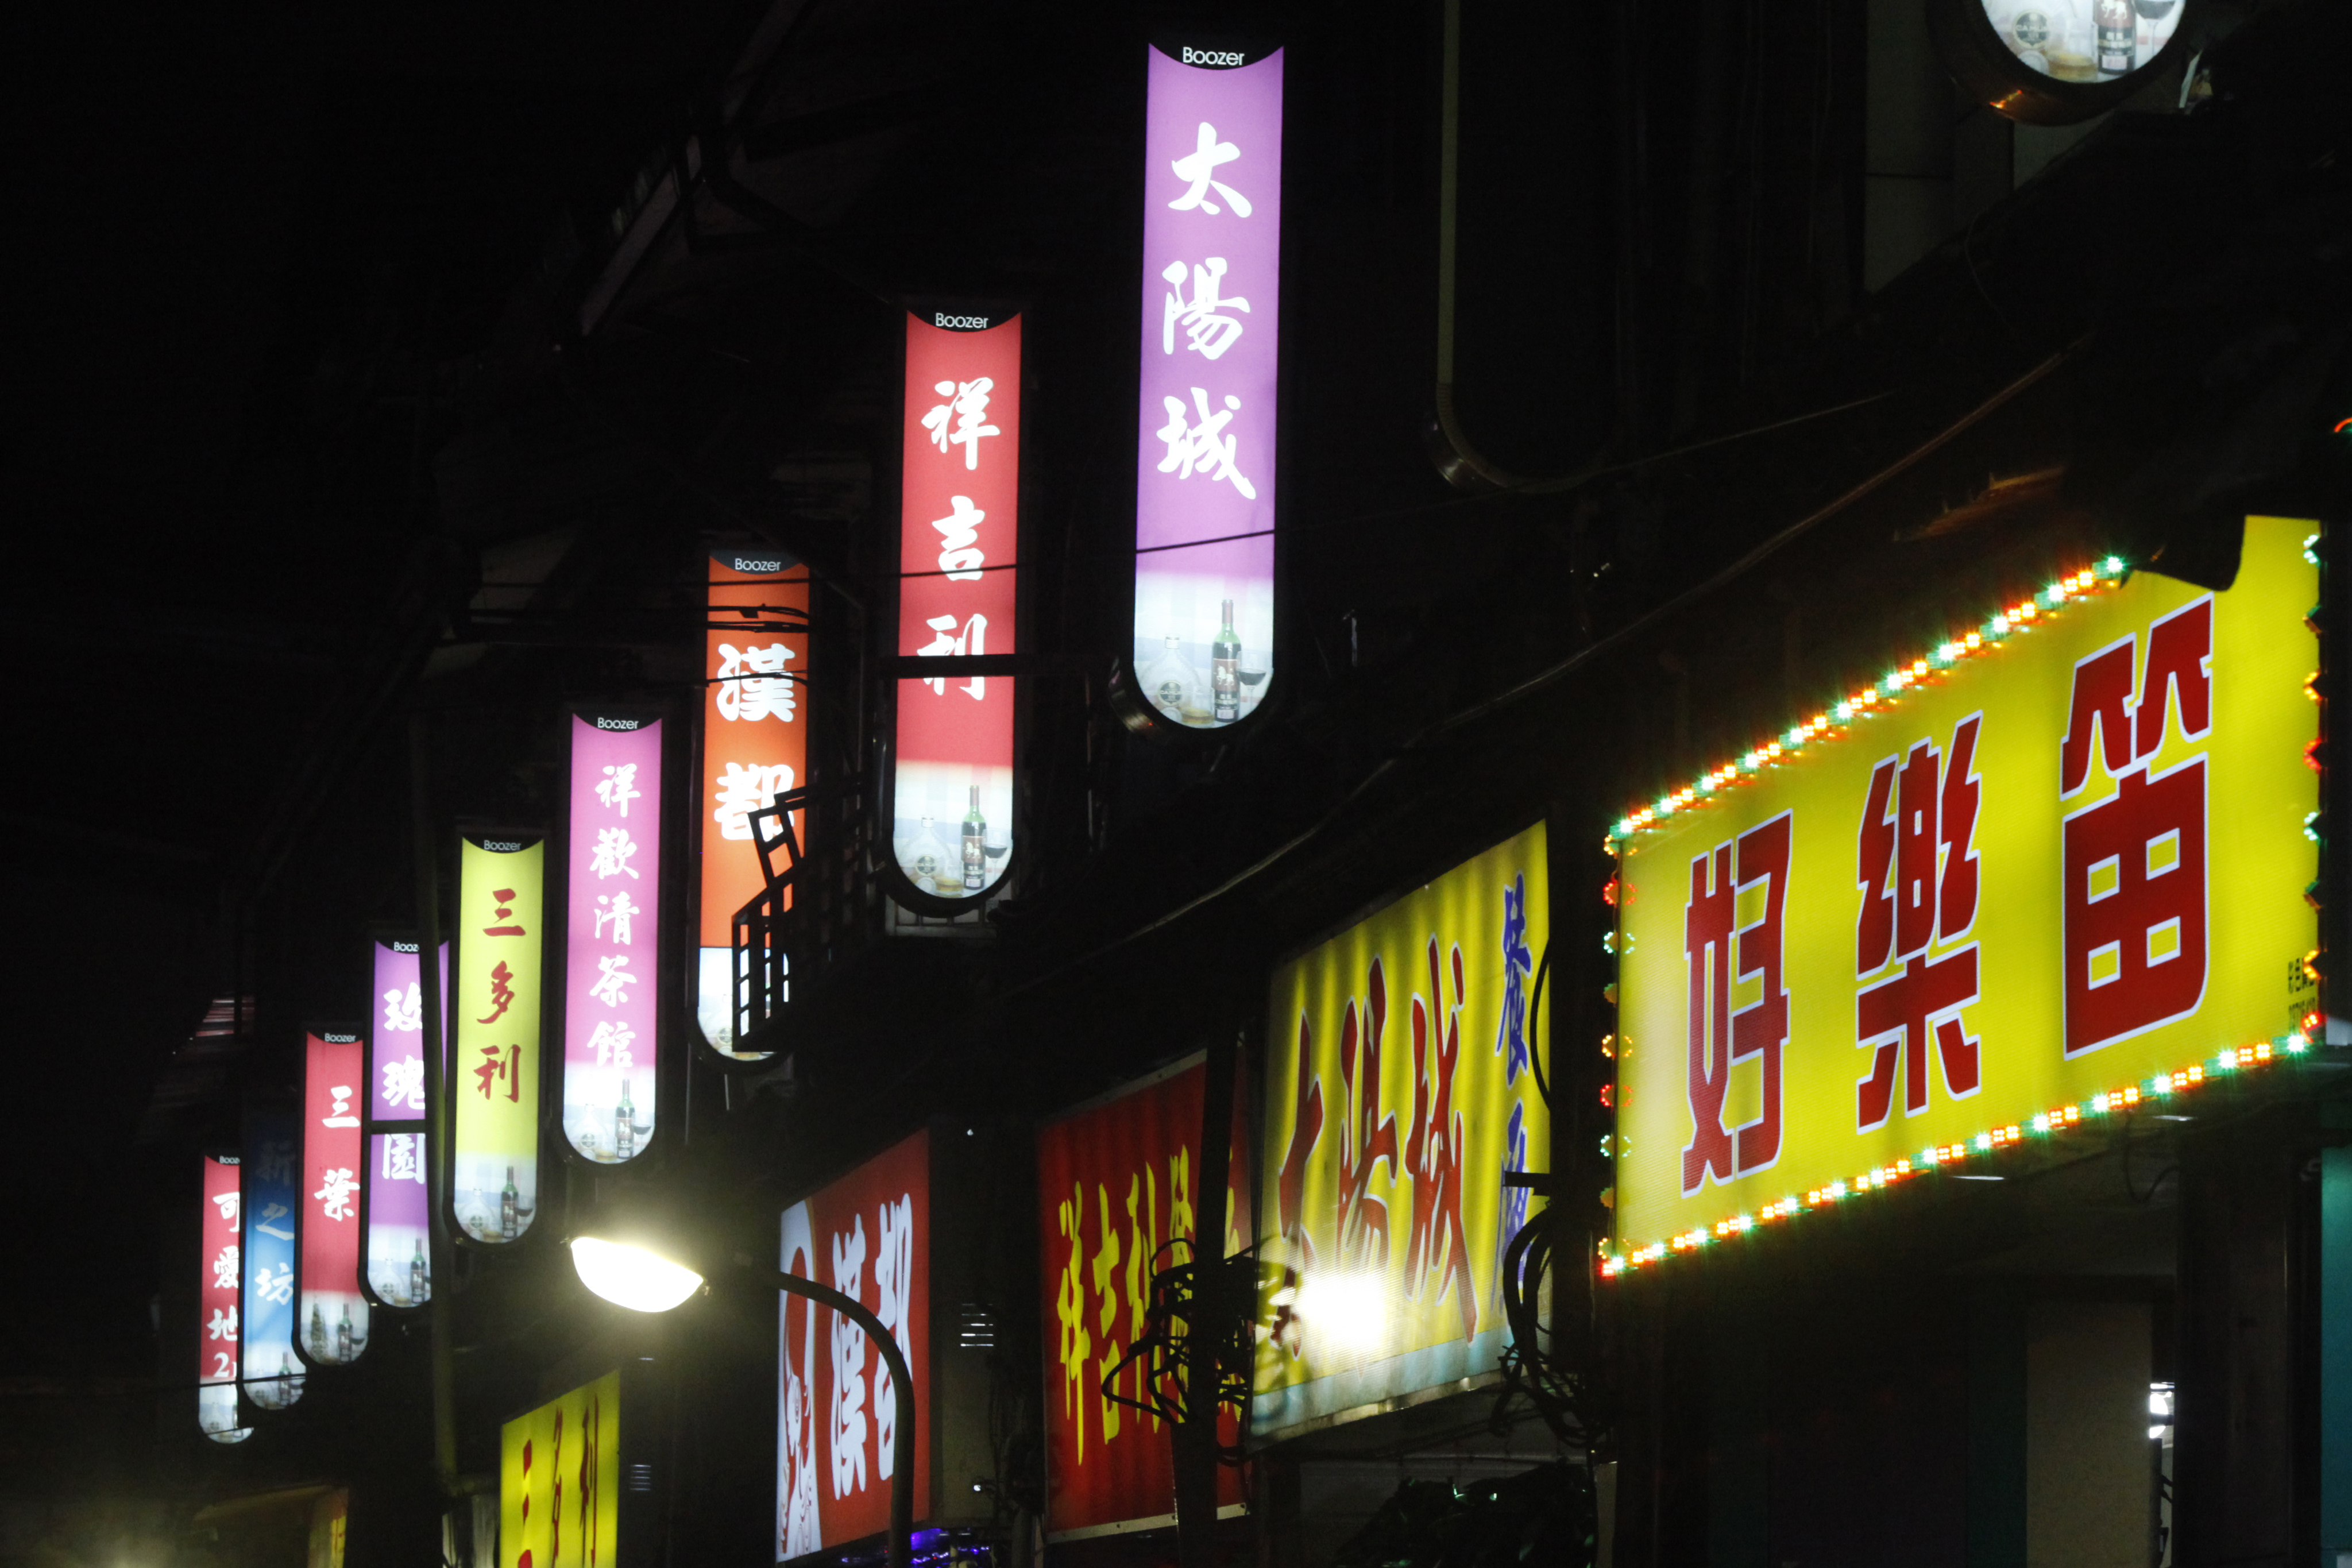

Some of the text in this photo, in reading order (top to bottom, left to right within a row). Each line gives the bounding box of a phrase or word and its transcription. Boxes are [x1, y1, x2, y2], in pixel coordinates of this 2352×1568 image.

[1182, 47, 1245, 66] Boozer
[935, 313, 989, 329] Boozer
[1157, 122, 1257, 500] 太陽城
[735, 558, 781, 571] Boozer
[917, 377, 1001, 701] 祥吉利
[597, 718, 639, 729] Boozer
[713, 643, 797, 843] 漢都
[483, 840, 521, 852] Boozer
[587, 763, 641, 1068] 祥歡清茶館
[1682, 592, 2215, 1199] 好樂笛
[325, 1033, 356, 1043] Boozer
[382, 982, 426, 1184] 玫瑰園
[476, 888, 526, 1103] 三多利
[314, 1086, 361, 1222] 三葉
[831, 1192, 913, 1500] 漢都
